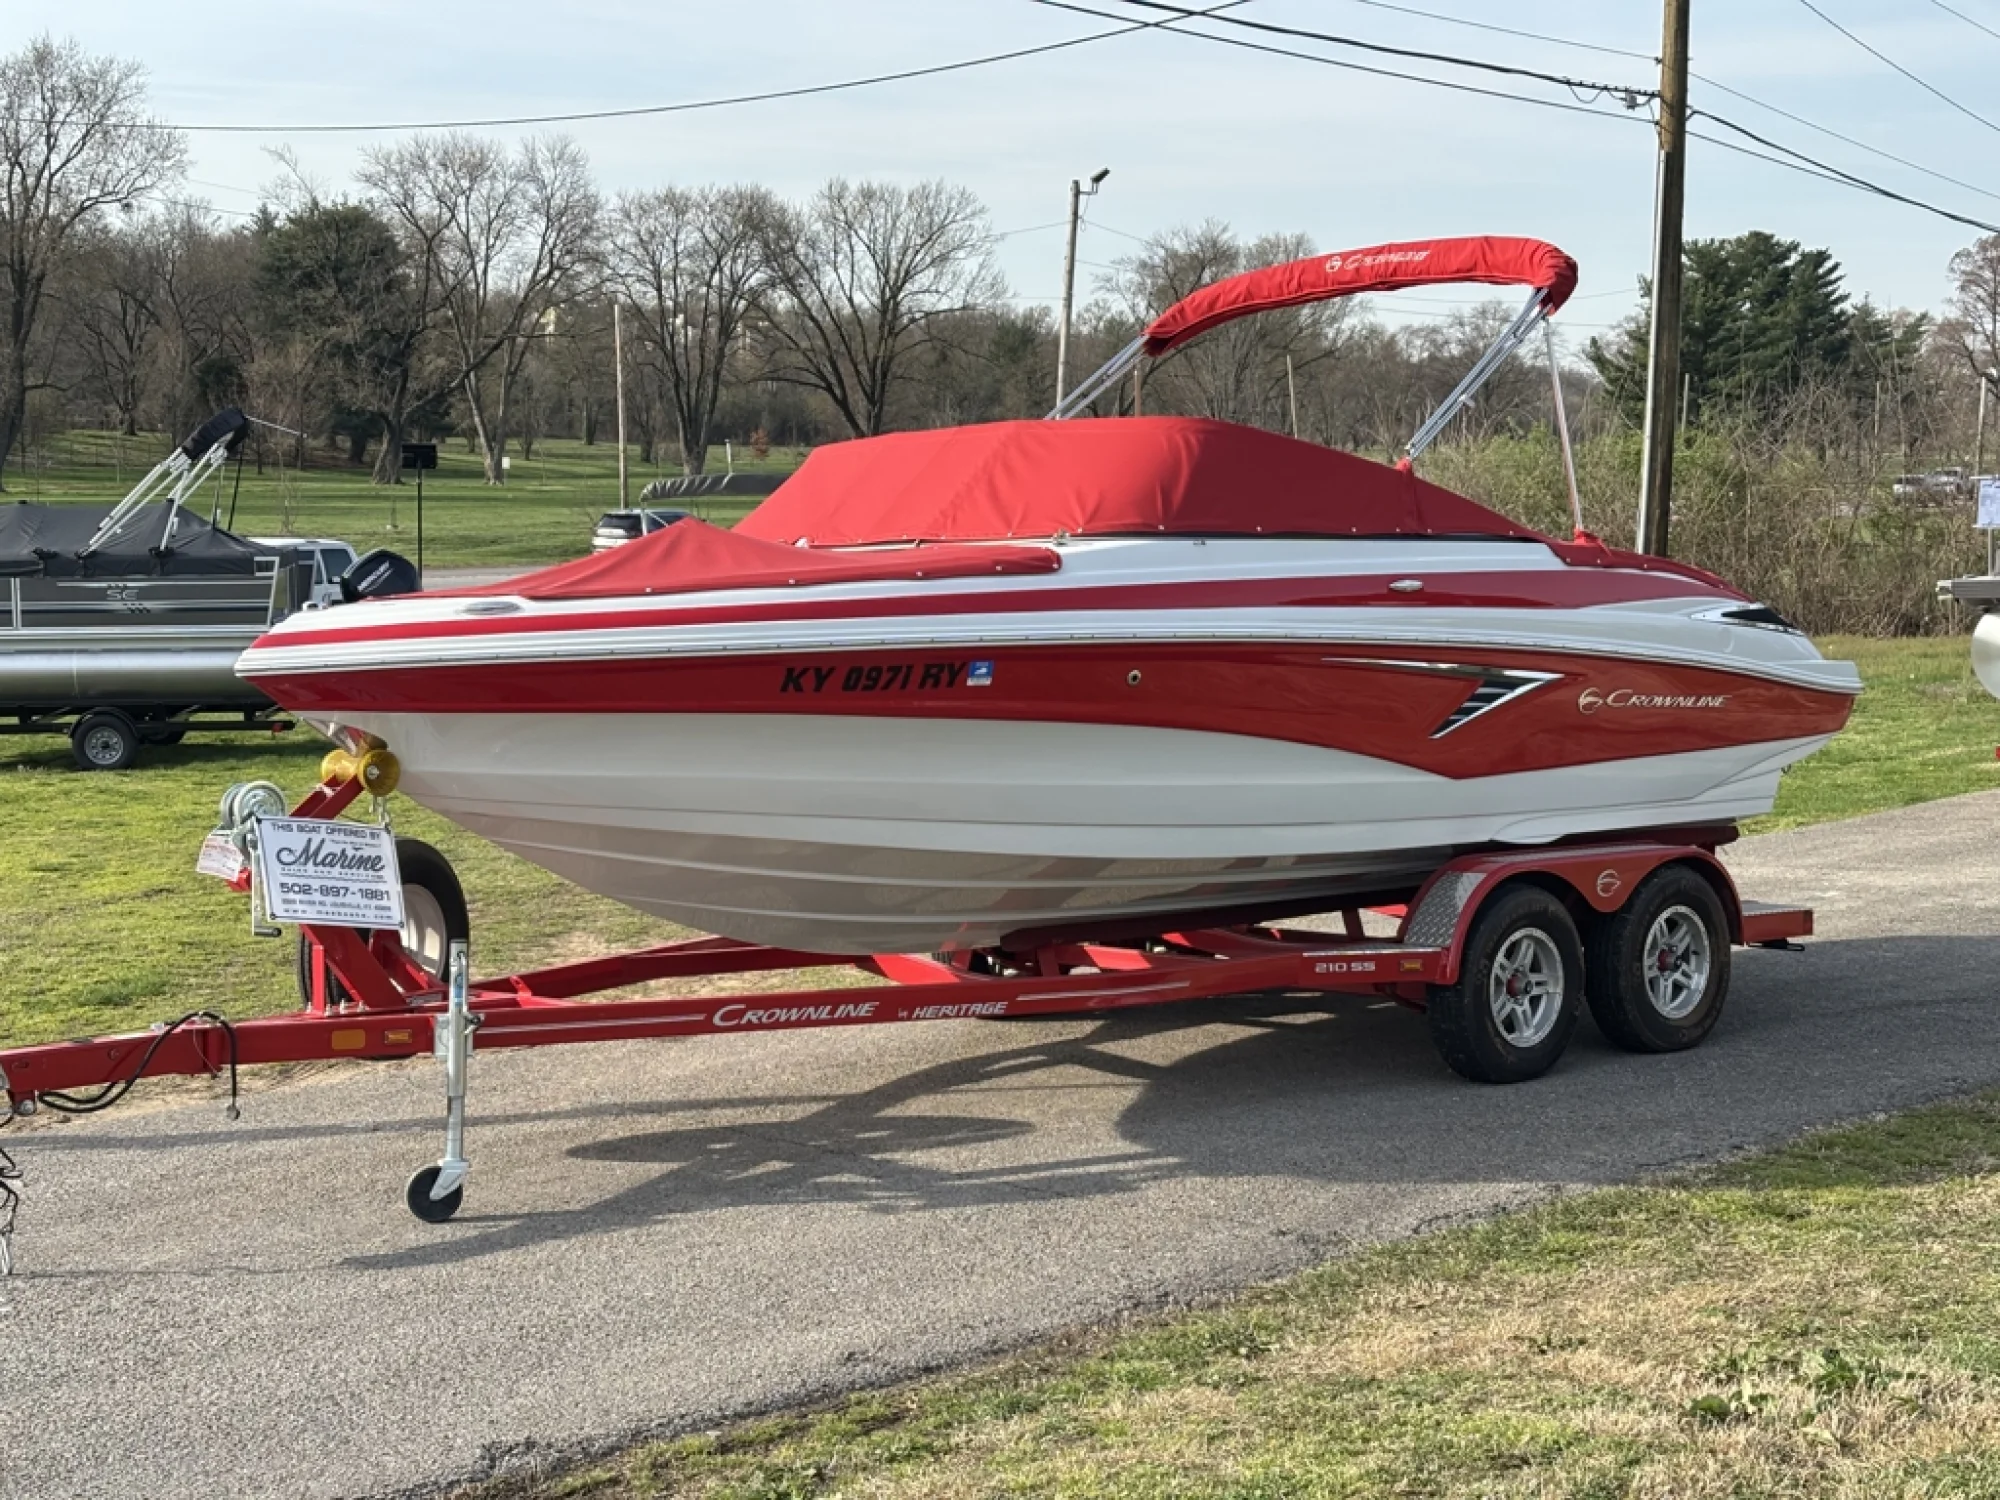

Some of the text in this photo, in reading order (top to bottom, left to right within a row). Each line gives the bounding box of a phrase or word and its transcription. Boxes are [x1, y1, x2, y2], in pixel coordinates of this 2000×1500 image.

[779, 667, 836, 692] KY
[841, 664, 914, 691] 0971
[917, 662, 967, 689] RY
[271, 822, 380, 840] THIS BOAT OFFERED BY
[276, 837, 386, 872] Marine
[280, 882, 391, 901] 502-897-1881
[1315, 961, 1376, 973] 210 SS
[912, 1001, 1008, 1019] HERITAGE
